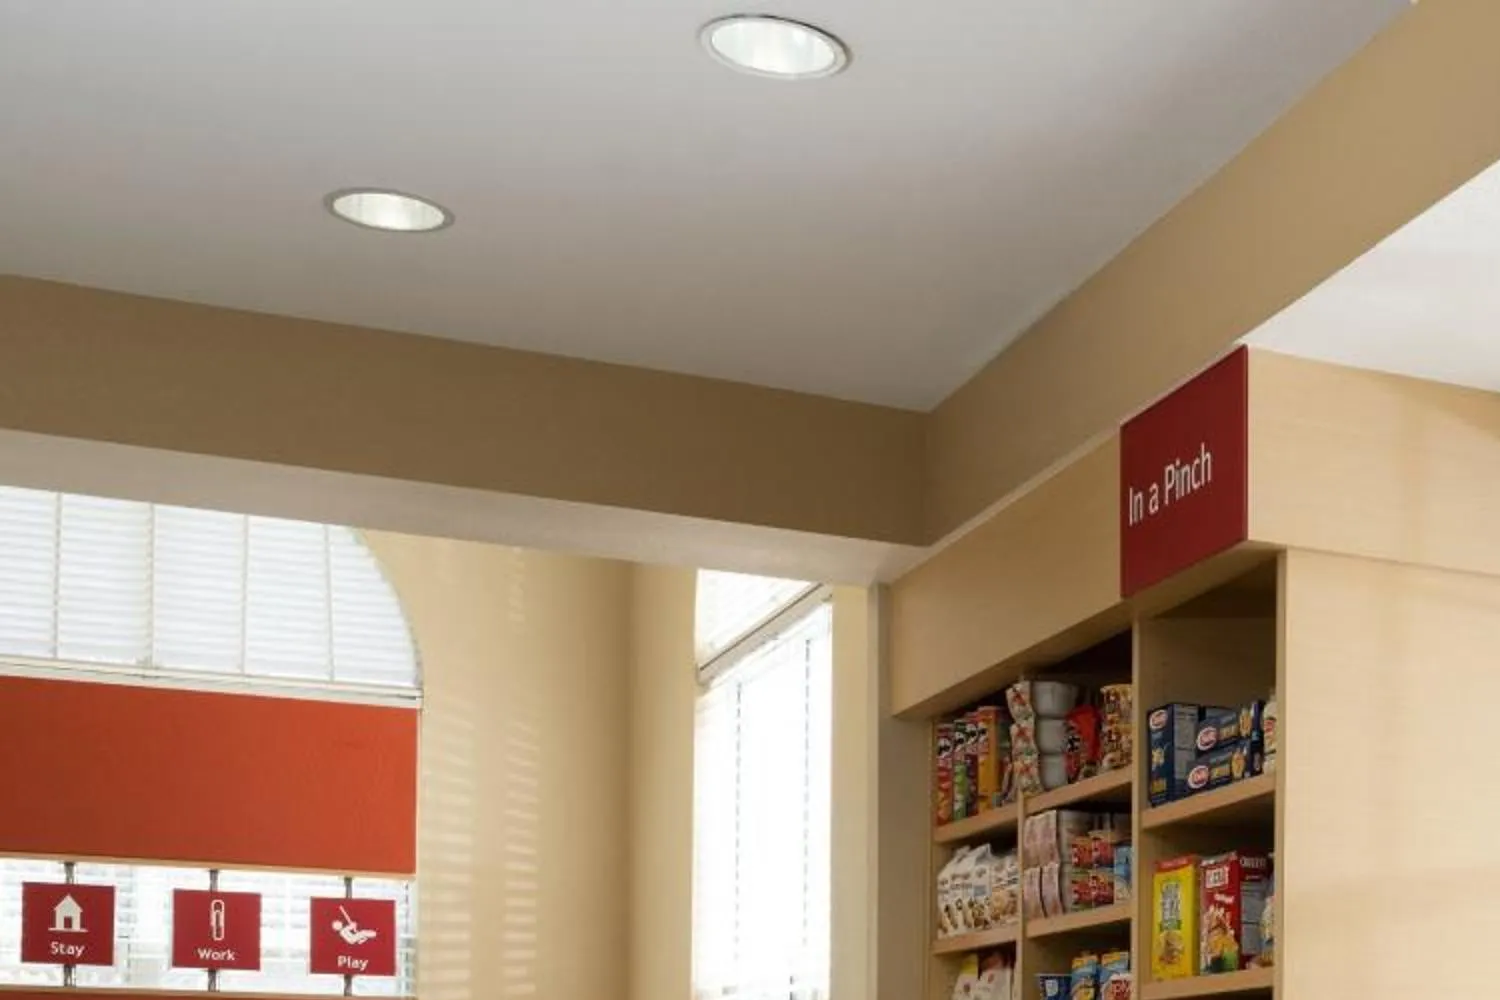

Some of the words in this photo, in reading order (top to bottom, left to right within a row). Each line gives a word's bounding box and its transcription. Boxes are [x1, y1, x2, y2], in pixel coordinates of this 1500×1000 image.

[1129, 487, 1144, 526] In
[1149, 482, 1159, 515] a
[1164, 442, 1212, 506] Pinch
[50, 941, 85, 958] Stay
[198, 947, 236, 962] Work
[337, 955, 369, 971] Play
